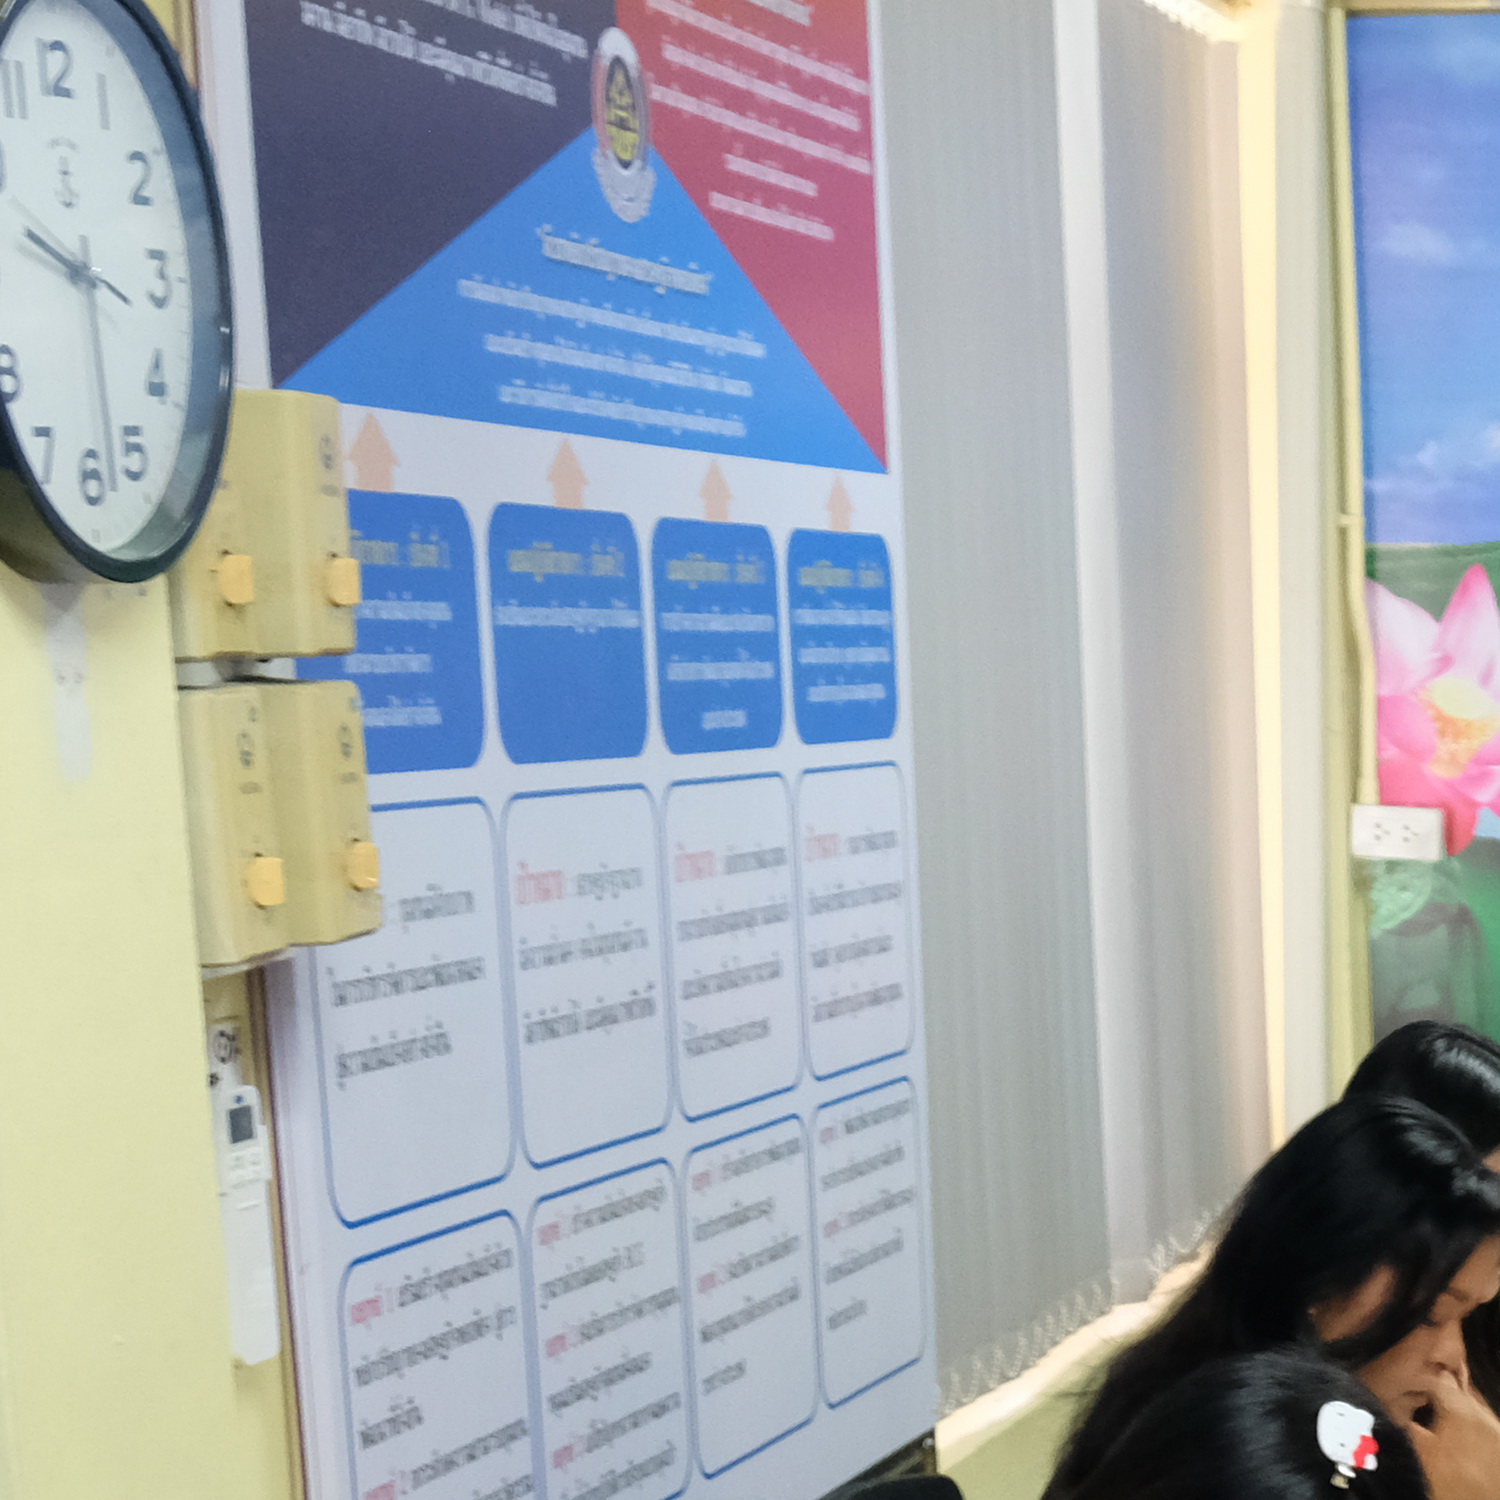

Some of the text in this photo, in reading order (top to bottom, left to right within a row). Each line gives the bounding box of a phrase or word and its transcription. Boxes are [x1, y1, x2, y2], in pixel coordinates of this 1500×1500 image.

[36, 38, 76, 99] 12
[127, 150, 153, 206] 2
[145, 248, 172, 309] 3
[145, 347, 168, 404] 4
[32, 425, 55, 486] 7
[78, 448, 106, 507] 6
[120, 424, 150, 482] 5
